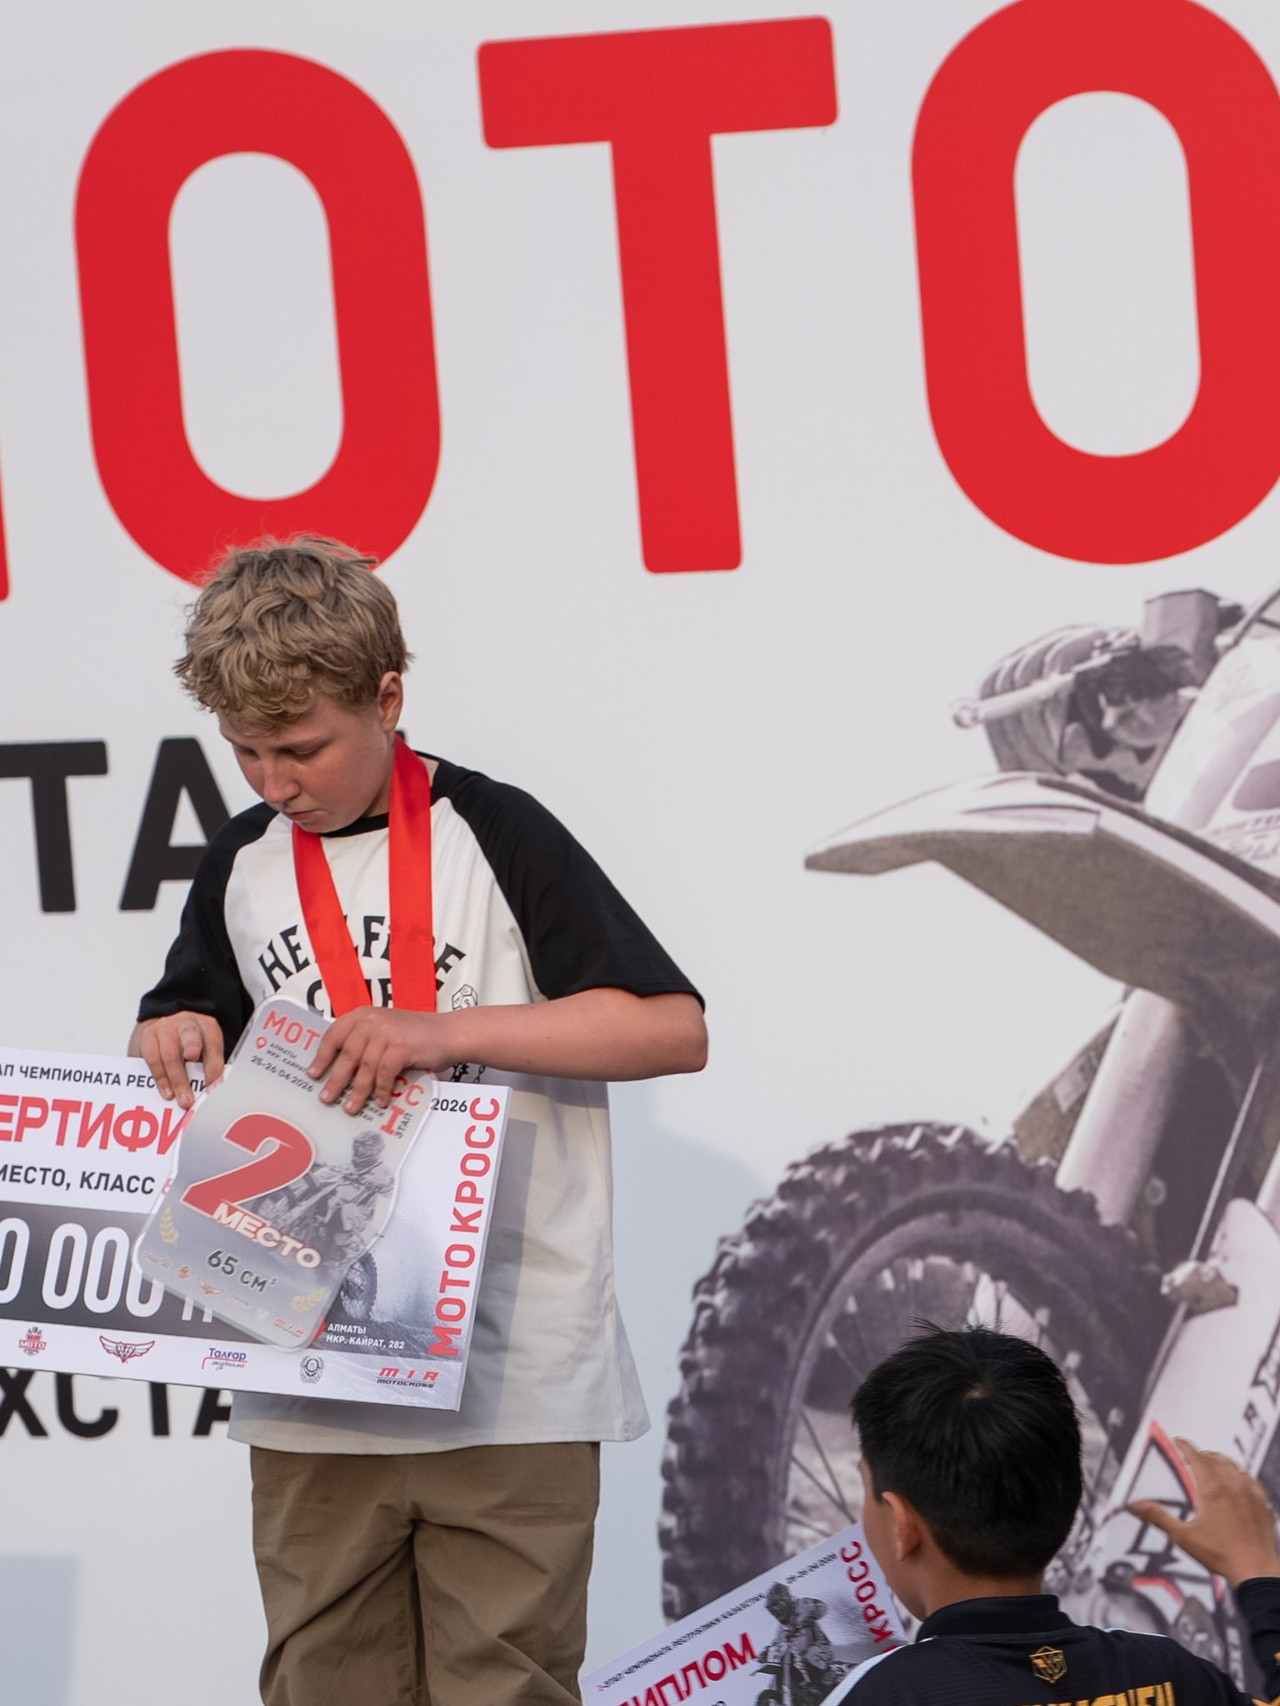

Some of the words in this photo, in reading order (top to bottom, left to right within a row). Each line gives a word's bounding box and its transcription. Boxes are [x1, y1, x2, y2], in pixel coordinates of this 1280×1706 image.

[19, 1065, 121, 1086] ЧЕМПИОНАТА
[431, 1097, 468, 1113] 2026
[79, 1171, 156, 1195] КЛАСС
[180, 1111, 315, 1221] 2
[209, 1201, 323, 1270] МЕСТО
[428, 1240, 478, 1357] МОТО
[453, 1096, 501, 1236] КРОСС
[207, 1248, 240, 1276] 65
[327, 1323, 367, 1334] АЛМАТЫ
[388, 1340, 406, 1350] 282
[840, 1540, 894, 1646] КРОСС
